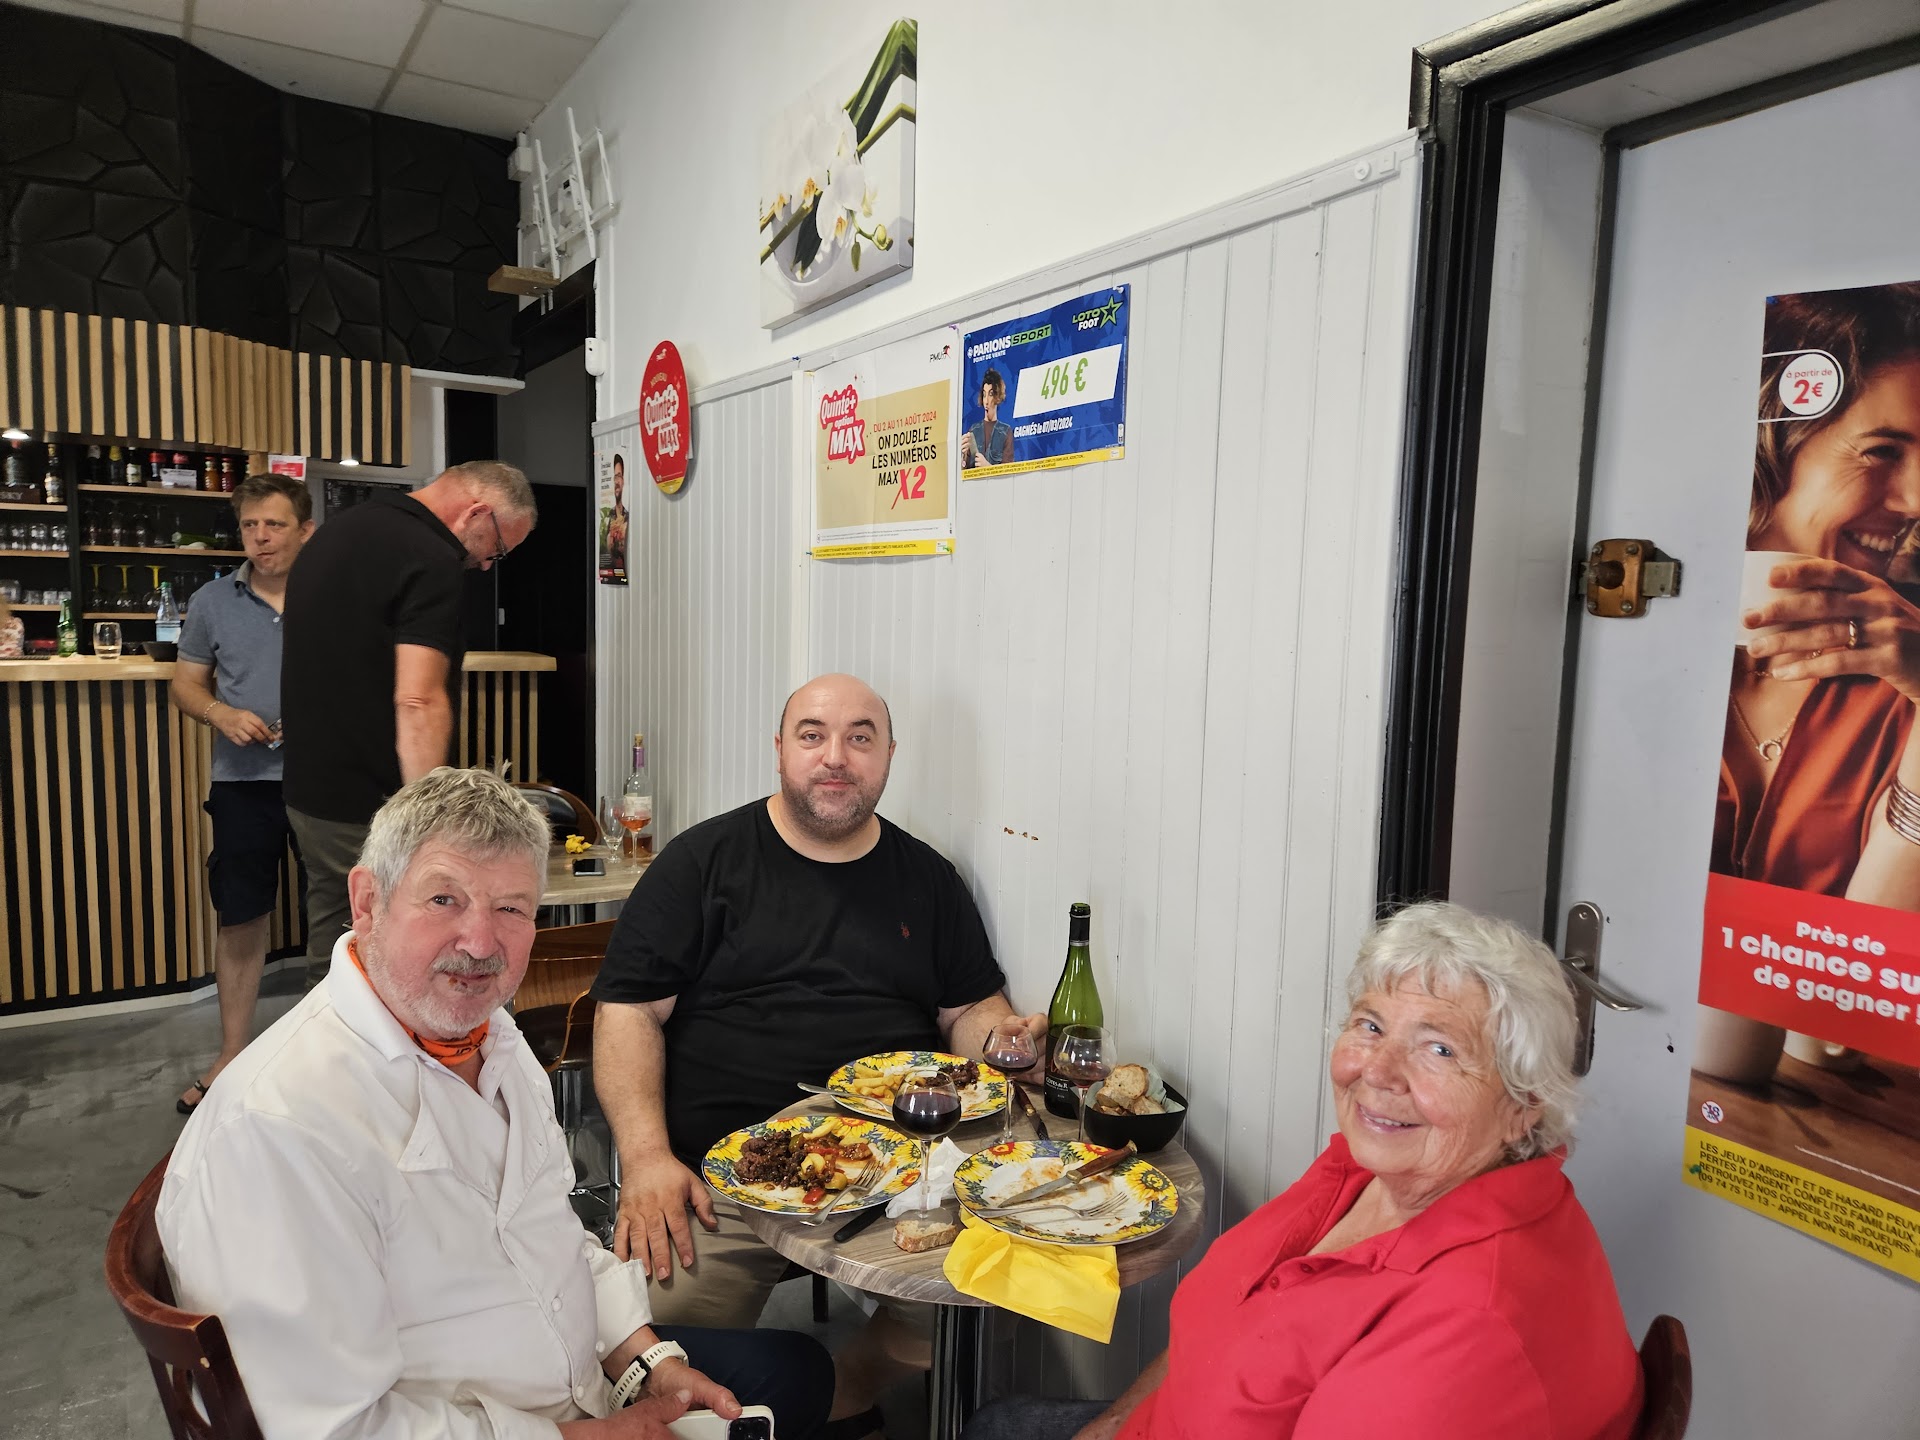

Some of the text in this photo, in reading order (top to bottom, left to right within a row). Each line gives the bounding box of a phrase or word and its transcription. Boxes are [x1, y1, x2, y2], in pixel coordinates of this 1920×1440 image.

[1072, 308, 1100, 324] LOTO
[1078, 317, 1100, 331] FOOT
[973, 327, 1050, 357] PARIONS SPORT
[973, 350, 1006, 364] POINT DE VENTE
[1041, 362, 1070, 400] 496
[1074, 357, 1088, 392] €
[1795, 369, 1820, 379] partir
[1822, 368, 1832, 376] de
[1792, 380, 1824, 404] 2€
[821, 393, 856, 420] Quinté+
[834, 417, 854, 428] option
[874, 411, 936, 433] DU 2 AU 11 AOÛT 2024
[1014, 416, 1073, 438] GAGNÉS le 07/03/2024
[659, 428, 678, 452] MAX
[830, 424, 864, 459] MAX
[878, 433, 891, 450] ON
[872, 445, 936, 470] LES NUMÉROS
[878, 470, 898, 486] MAX
[1796, 921, 1886, 956] Près de
[1721, 926, 1733, 948] 1
[1740, 934, 1872, 982] chance
[1754, 965, 1790, 990] de
[1796, 978, 1910, 1021] gagner
[1700, 1140, 1718, 1154] LES
[1720, 1150, 1746, 1165] JEUX
[1749, 1159, 1800, 1186] D'ARGENT
[1803, 1181, 1816, 1192] ET
[1818, 1186, 1833, 1198] DE
[1836, 1193, 1884, 1218] HASARD
[1700, 1151, 1737, 1172] PERTES
[1740, 1166, 1791, 1194] D'ARGENT,
[1794, 1188, 1848, 1216] CONFLITS
[1700, 1162, 1754, 1190] RETROUVEZ
[1756, 1184, 1778, 1198] NOS
[1780, 1194, 1830, 1220] CONSEILS
[1833, 1214, 1856, 1230] SUR
[1699, 1172, 1713, 1184] (09
[1716, 1178, 1726, 1189] 74
[1729, 1184, 1740, 1194] 75
[1744, 1190, 1754, 1200] 13
[1757, 1194, 1769, 1206] 13
[1778, 1204, 1810, 1224] APPEL
[1812, 1218, 1836, 1234] NON
[1838, 1228, 1892, 1258] SURTAXÉ)
